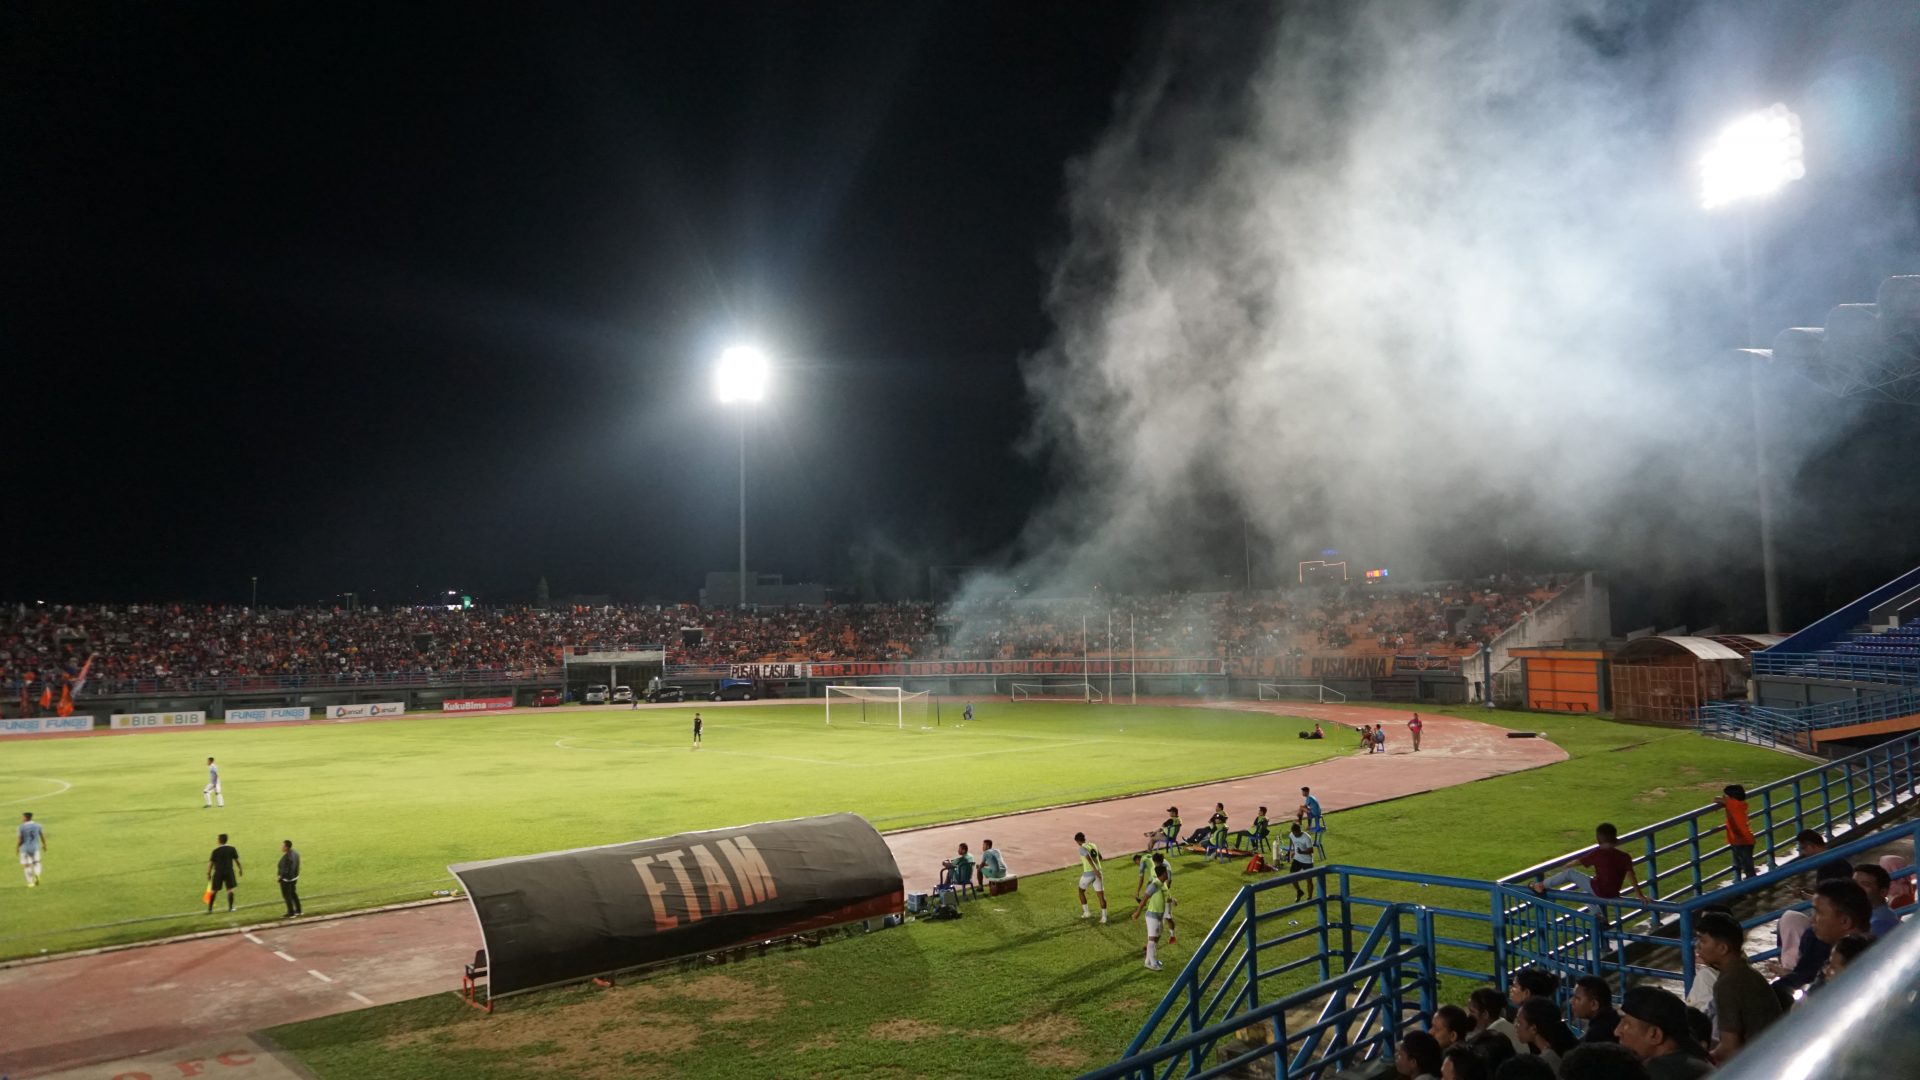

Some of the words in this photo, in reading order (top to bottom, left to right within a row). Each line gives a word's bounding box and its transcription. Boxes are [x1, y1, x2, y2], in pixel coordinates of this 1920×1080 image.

[764, 664, 799, 678] CASUAL
[1312, 657, 1386, 676] PUSAMANIA
[443, 701, 486, 711] KukuBima
[132, 716, 156, 726] BIB
[175, 714, 198, 724] BIB
[631, 835, 778, 932] ETAM
